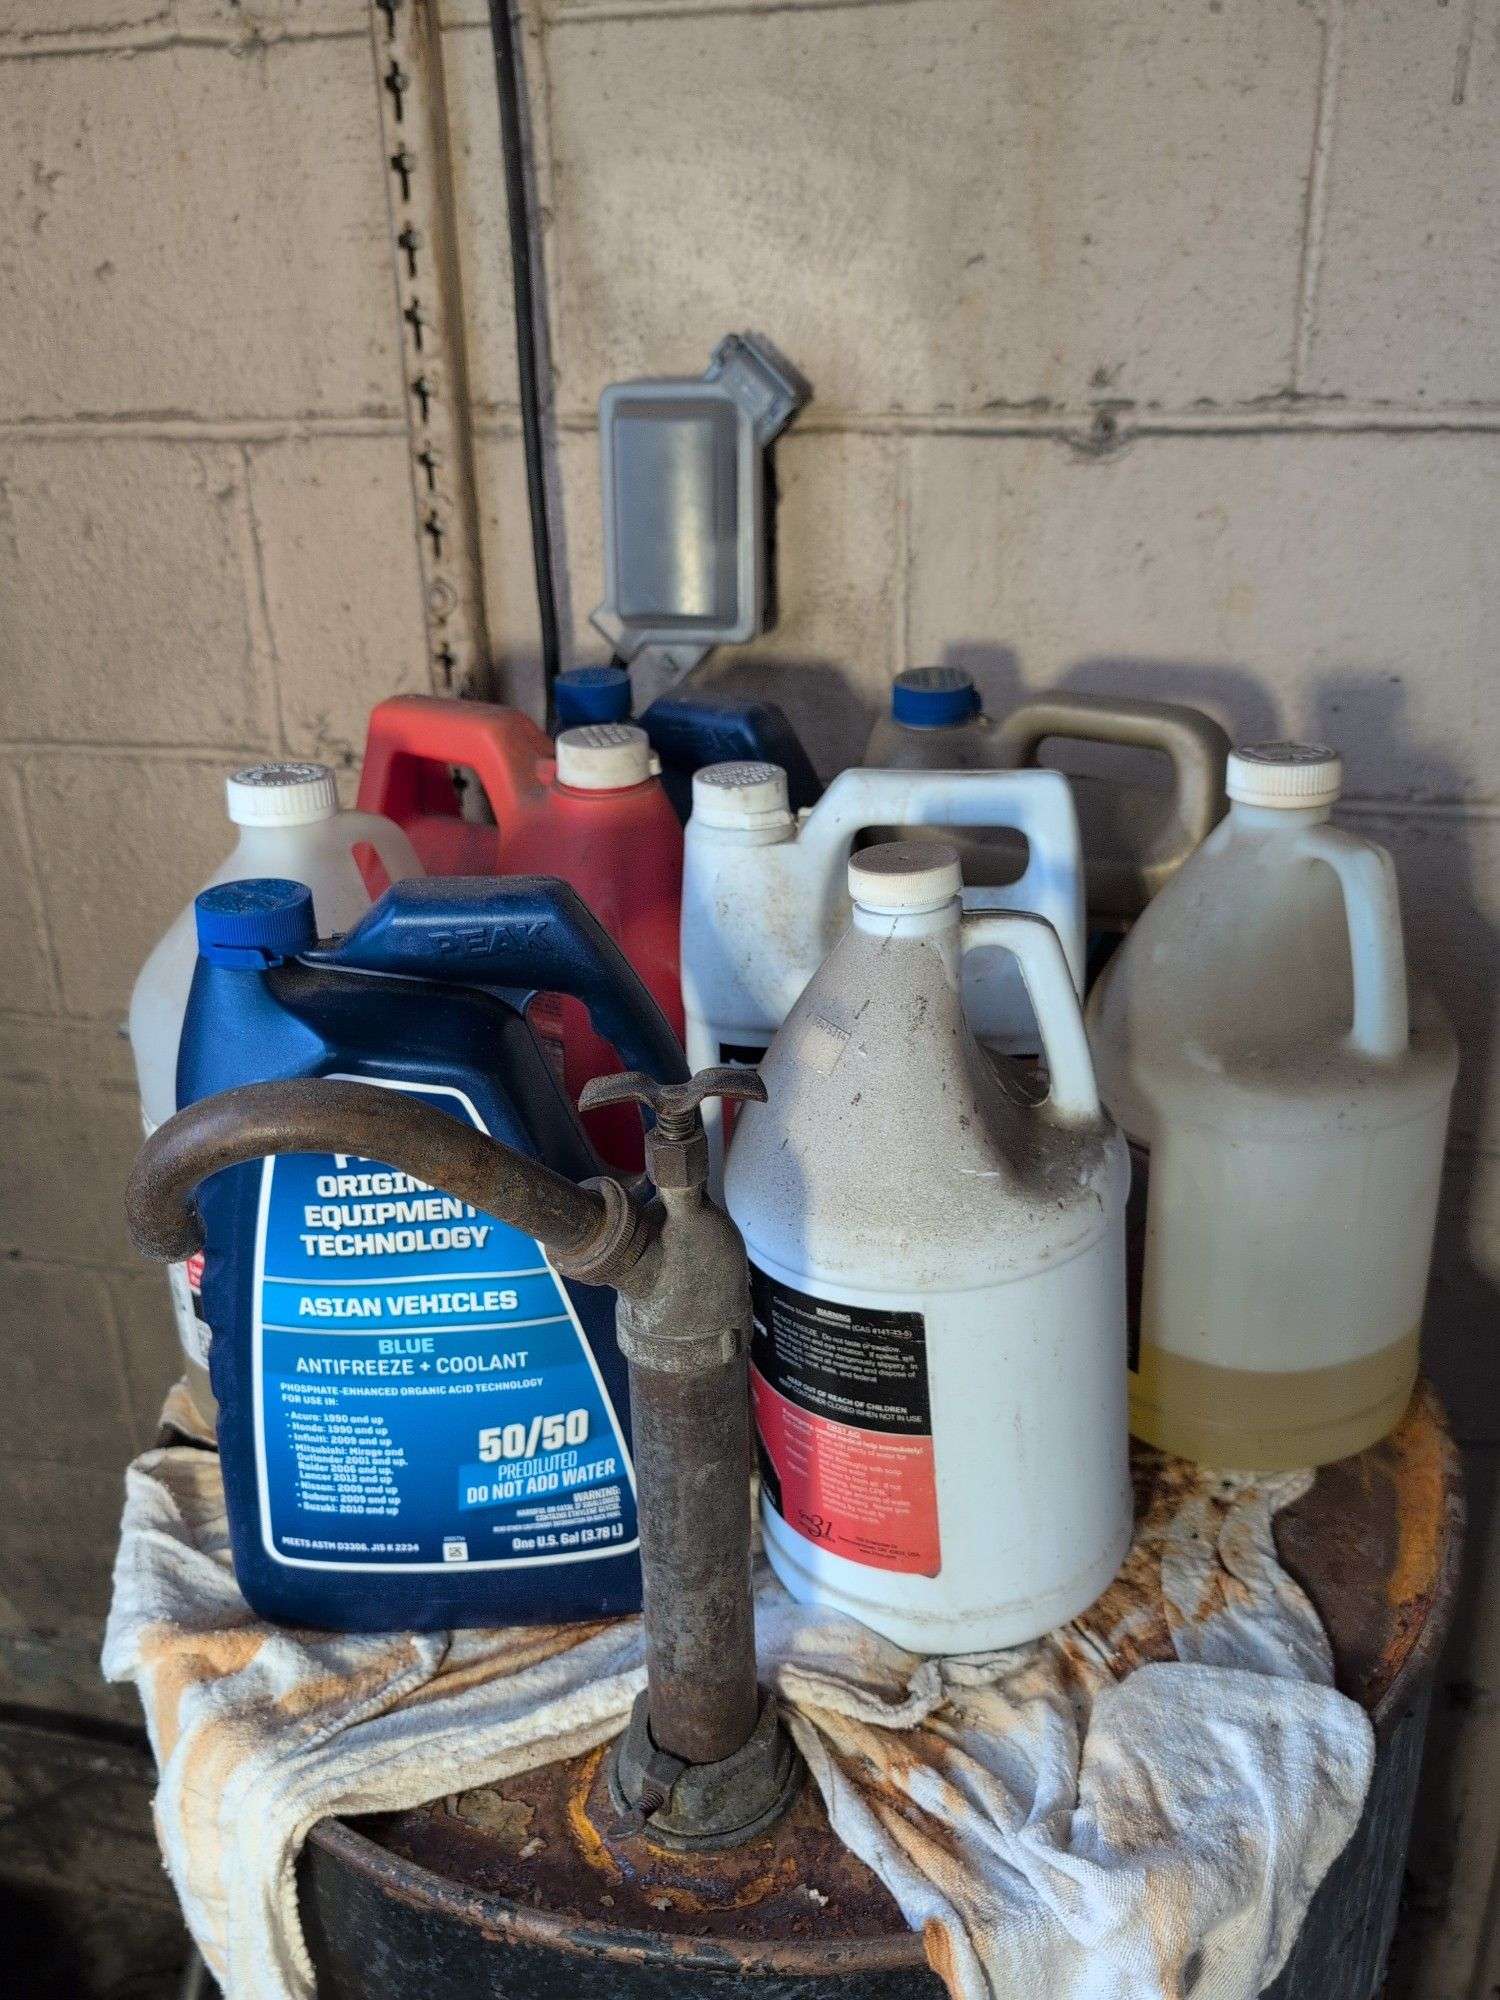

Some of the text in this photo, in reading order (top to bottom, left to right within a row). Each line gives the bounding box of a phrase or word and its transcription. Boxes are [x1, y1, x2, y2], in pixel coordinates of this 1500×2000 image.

[316, 1171, 435, 1198] ORIGIN
[300, 1225, 490, 1257] TECHNOLOGY
[299, 1289, 518, 1317] ASIAN VEHICLES
[378, 1337, 435, 1355] BLUE
[296, 1351, 529, 1376] ANTIFREEZE + COOLANT
[400, 1385, 447, 1396] ORGANIC
[449, 1384, 474, 1395] ACID
[475, 1377, 544, 1393] TECHNOLOGY
[282, 1393, 301, 1403] FOR
[303, 1396, 323, 1406] USE
[854, 1400, 865, 1408] OF
[350, 1415, 370, 1424] and
[371, 1417, 384, 1425] up
[879, 1412, 895, 1421] NOT
[355, 1427, 373, 1435] and
[375, 1428, 388, 1436] up
[478, 1408, 589, 1463] 50/50
[359, 1437, 378, 1446] and
[379, 1439, 392, 1447] up
[384, 1448, 404, 1456] and
[372, 1457, 391, 1465] and
[497, 1450, 577, 1481] PREDILUTED
[358, 1466, 377, 1474] and
[359, 1475, 378, 1483] and
[380, 1476, 393, 1485] up
[466, 1457, 616, 1504] DO NOT ADD WATER
[365, 1485, 384, 1494] and
[385, 1486, 398, 1495] up
[368, 1495, 387, 1505] and
[388, 1497, 401, 1506] up
[366, 1505, 384, 1514] and
[386, 1507, 399, 1516] up
[282, 1536, 311, 1548] MEETS
[312, 1540, 336, 1550] ASTM
[512, 1537, 536, 1551] One
[536, 1533, 558, 1548] U.S.
[560, 1530, 580, 1545] Gal
